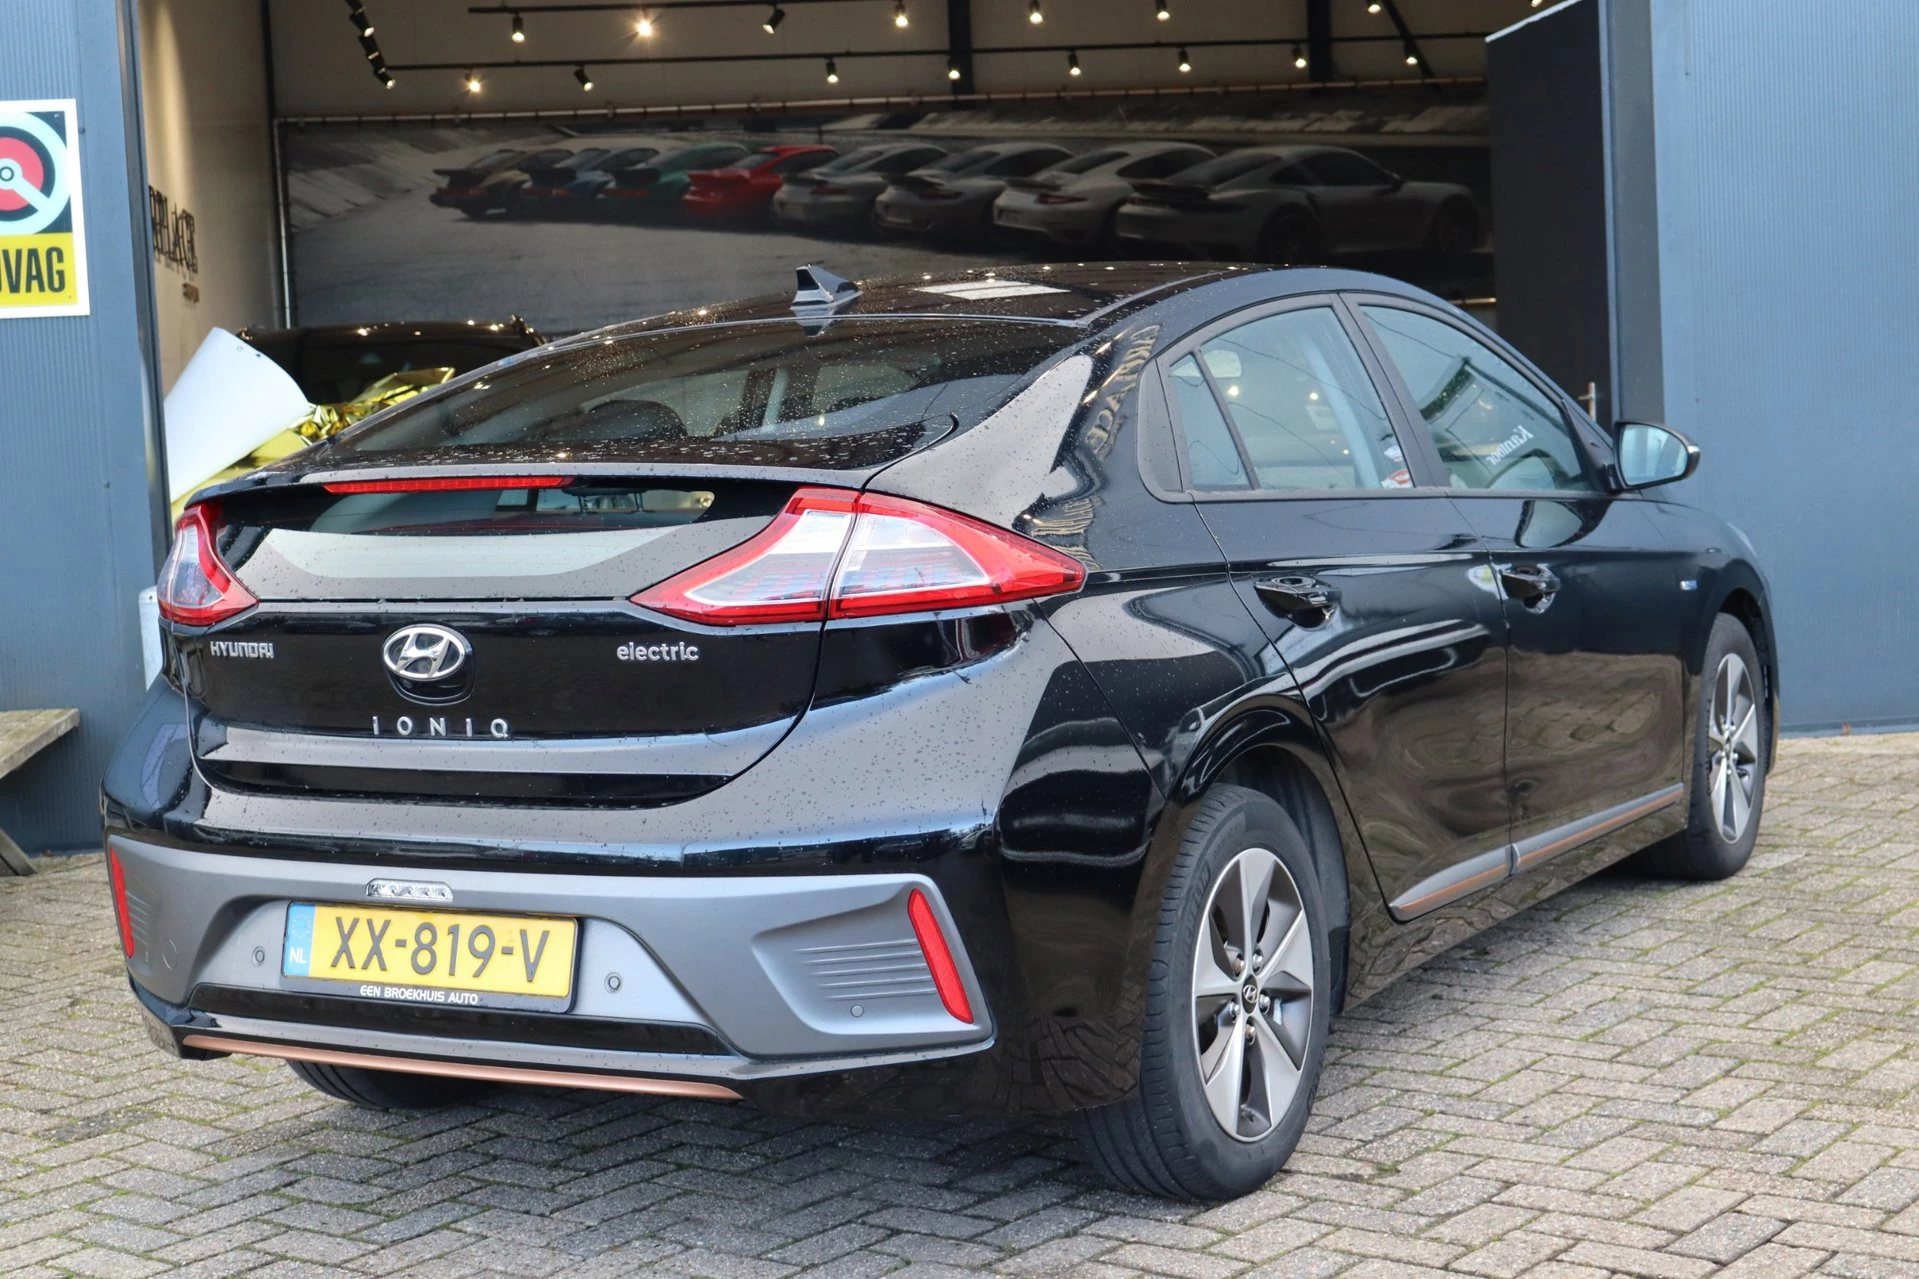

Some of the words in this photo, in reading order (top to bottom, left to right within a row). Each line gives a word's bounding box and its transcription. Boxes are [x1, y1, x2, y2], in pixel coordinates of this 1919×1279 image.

[0, 246, 66, 293] VAG
[209, 641, 275, 659] HYUNDAI
[616, 641, 699, 661] electric
[372, 715, 509, 738] IONIQ
[289, 948, 307, 964] NL
[330, 916, 550, 983] XX-819-V
[359, 984, 381, 998] EEN
[384, 986, 446, 1003] BROEKHUIS
[447, 991, 479, 1006] AUTO
